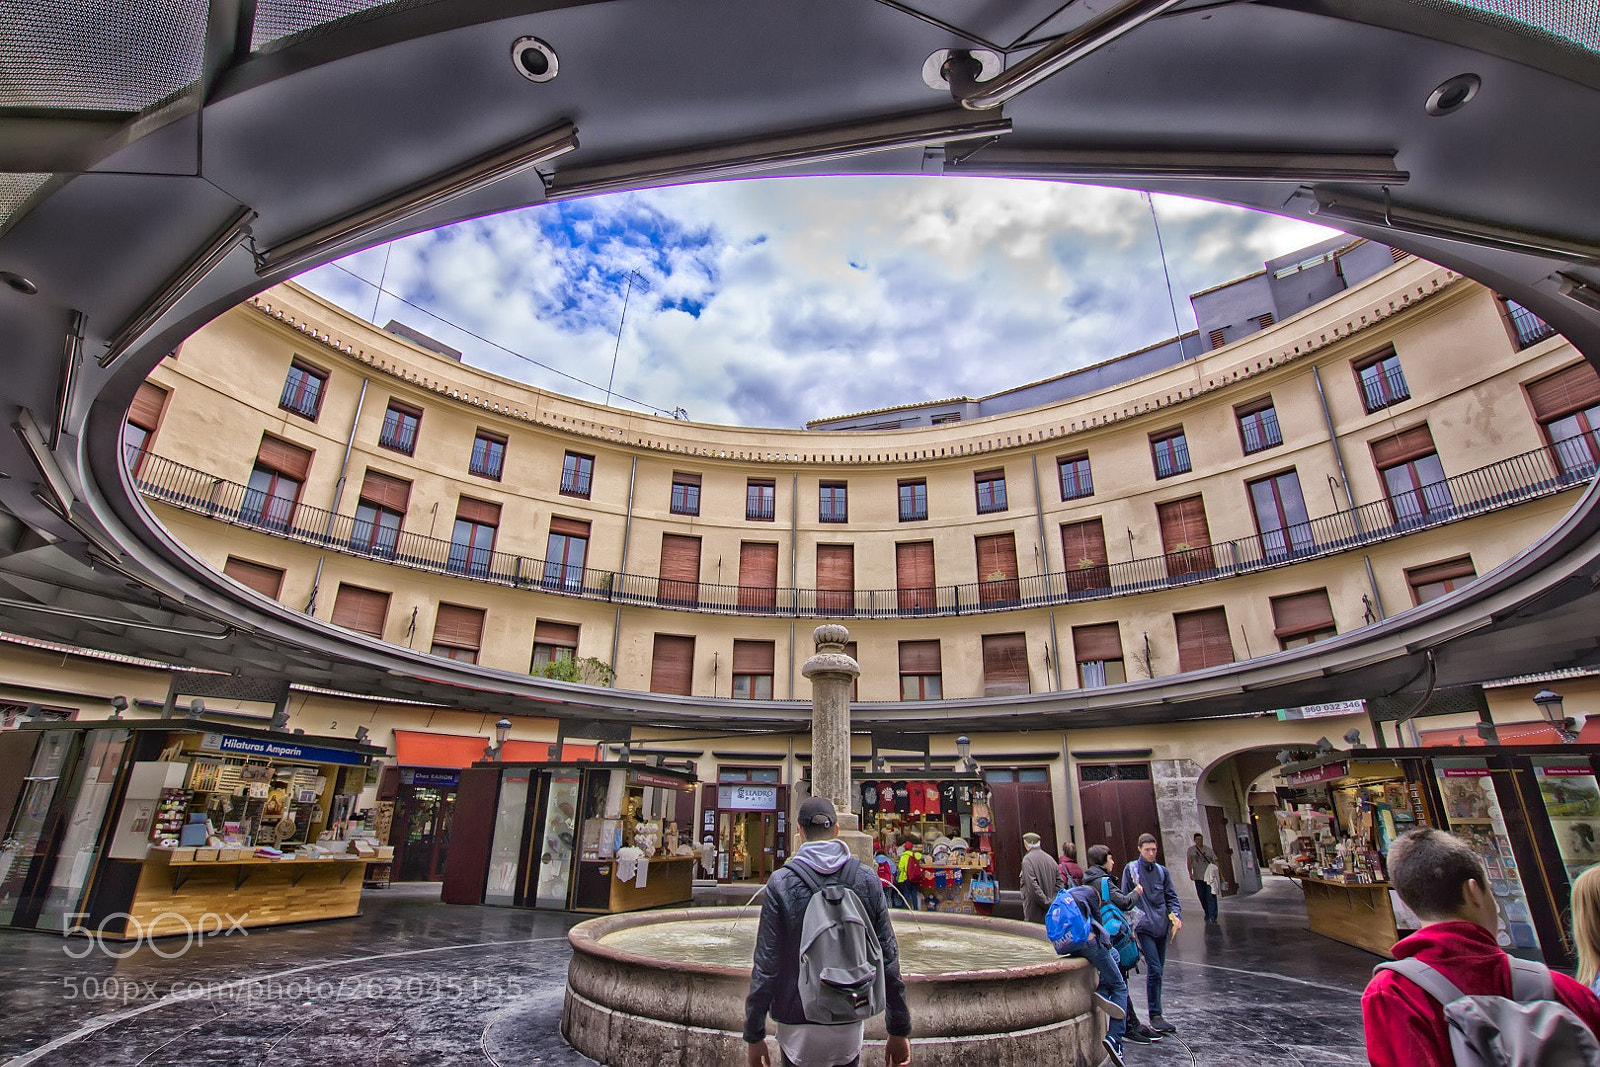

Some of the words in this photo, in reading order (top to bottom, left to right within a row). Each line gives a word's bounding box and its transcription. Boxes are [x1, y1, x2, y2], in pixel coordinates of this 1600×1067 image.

[1304, 705, 1321, 713] 960
[1323, 703, 1341, 711] 032
[1343, 700, 1360, 708] 346
[330, 721, 338, 730] 2
[223, 738, 265, 752] Hilaturas
[1342, 765, 1347, 775] 1
